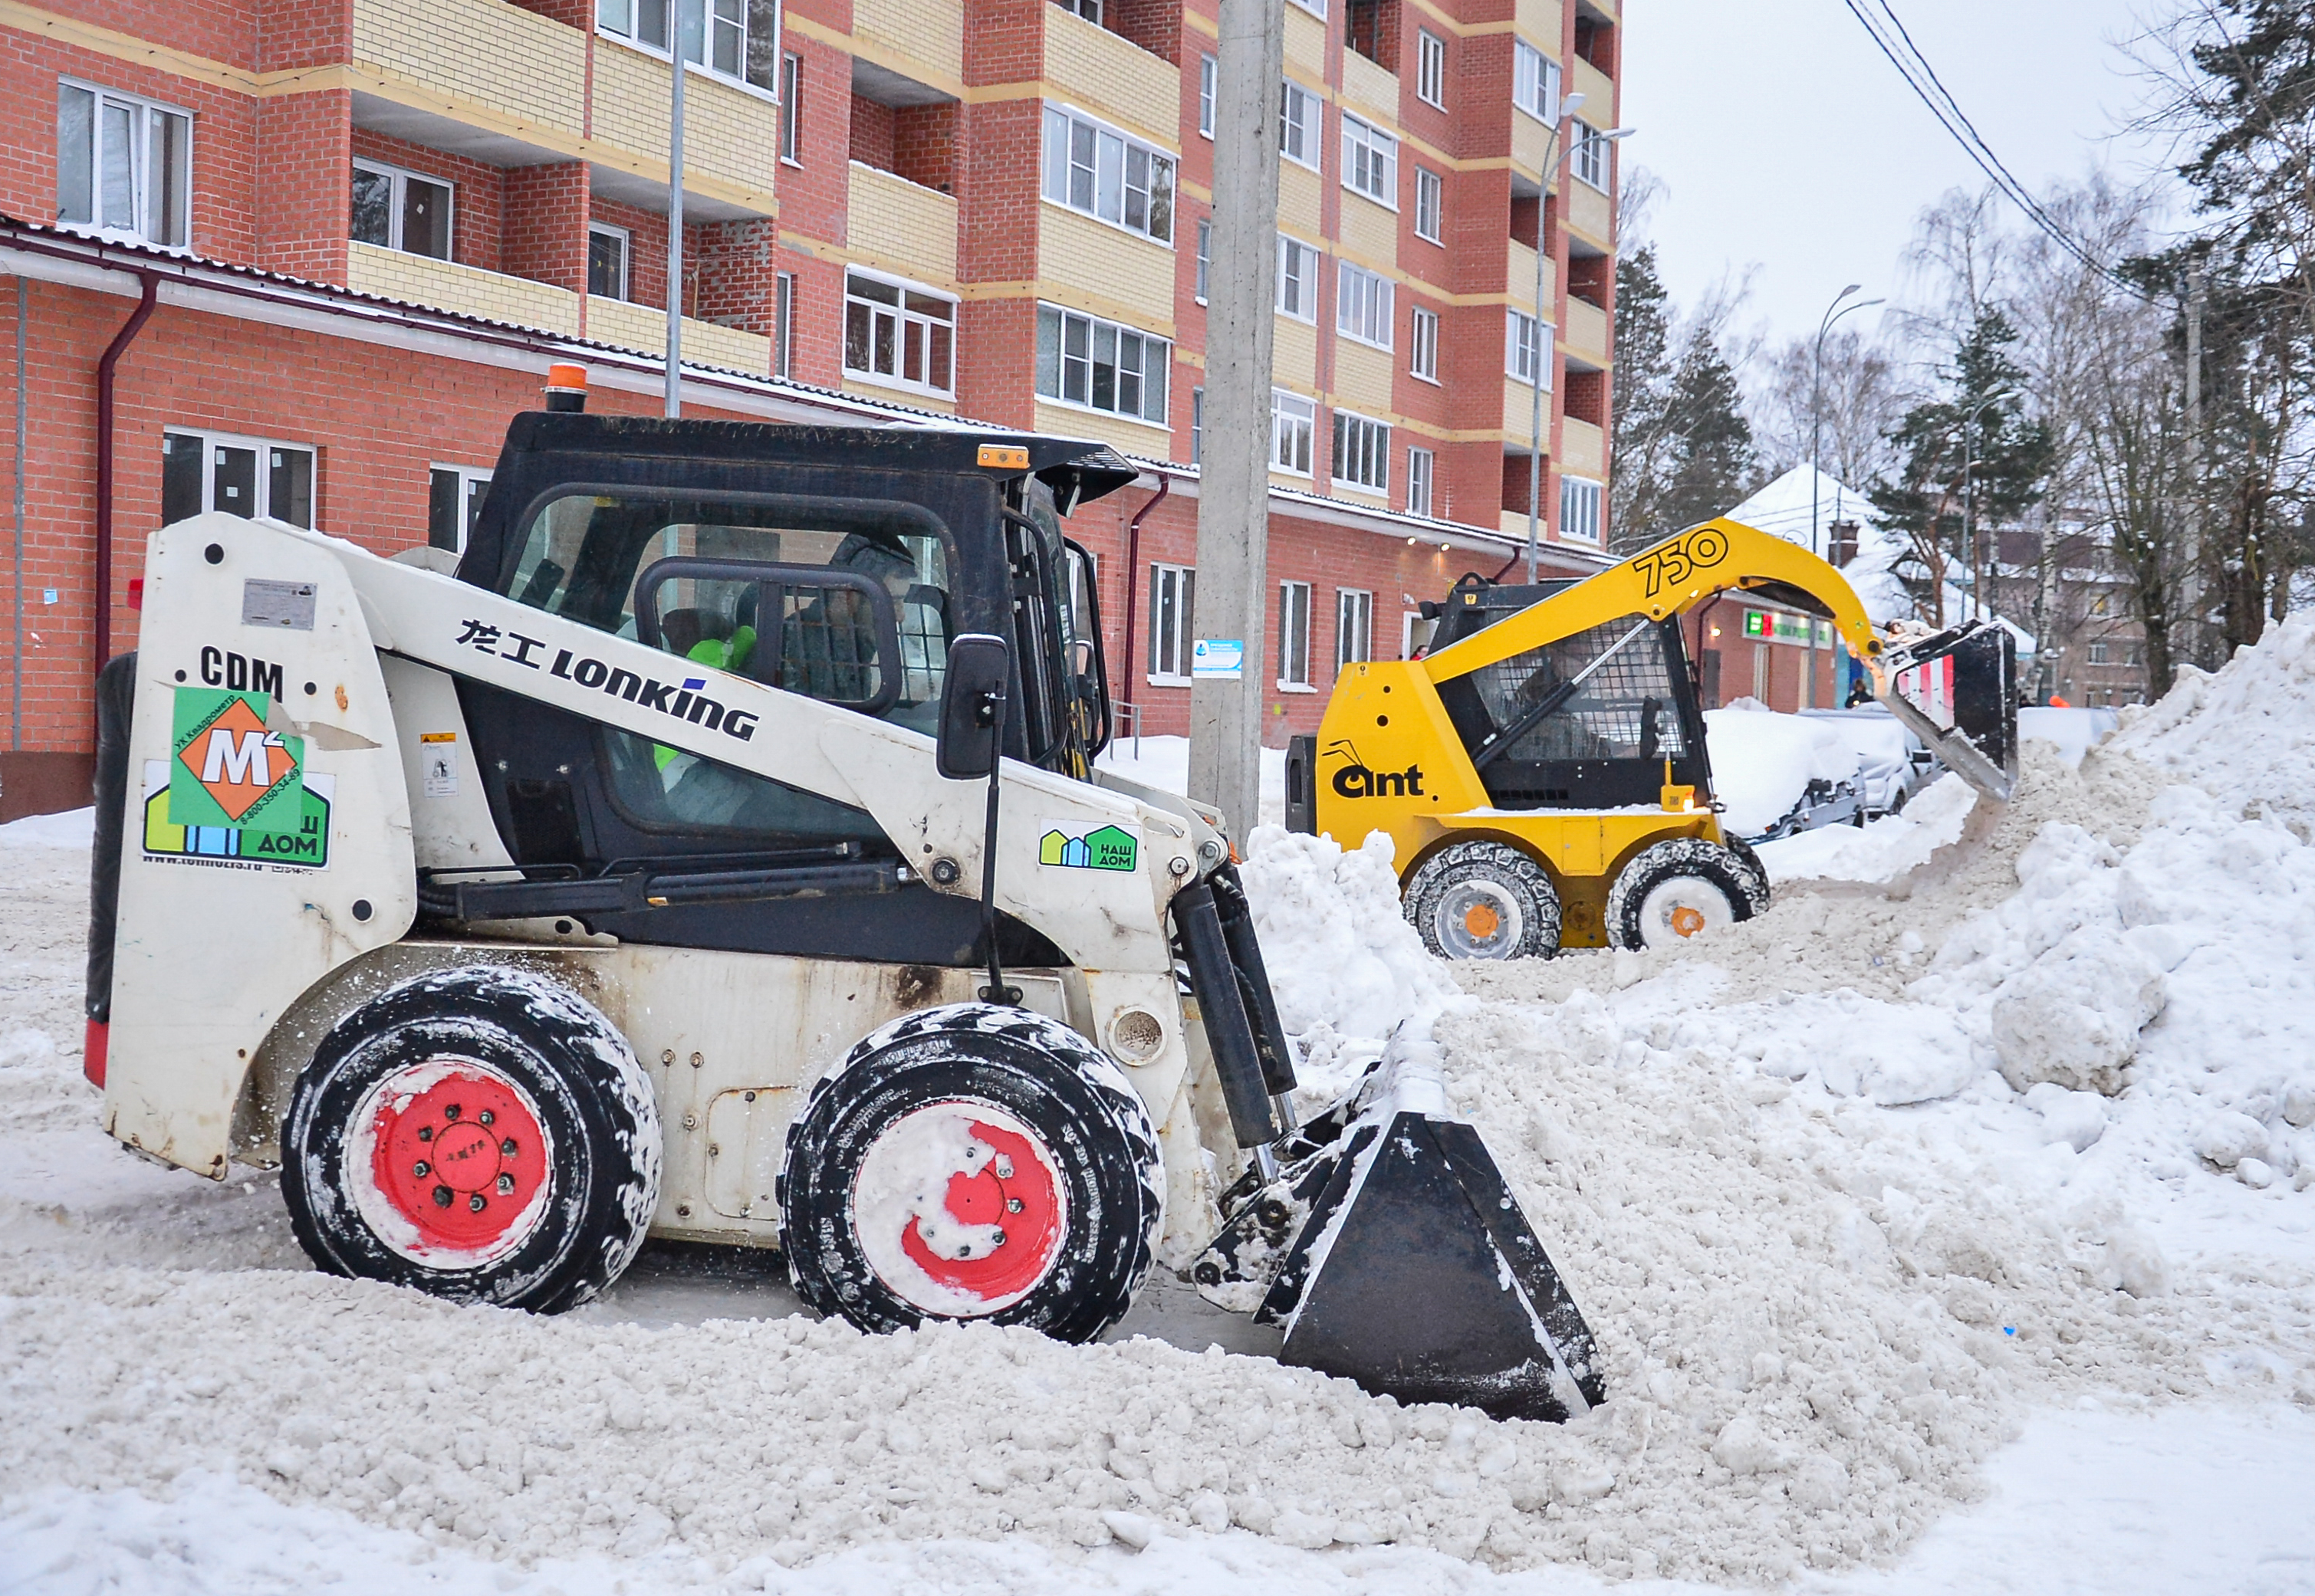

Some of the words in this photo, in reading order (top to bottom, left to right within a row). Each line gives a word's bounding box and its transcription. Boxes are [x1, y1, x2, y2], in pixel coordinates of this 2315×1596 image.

[1633, 528, 1728, 599] 750
[455, 619, 545, 669] 龙工
[201, 645, 283, 704] CDM
[240, 768, 301, 826] 8-800-350-34-89
[258, 835, 317, 856] ДОМ
[1099, 855, 1131, 867] ДОМ
[1100, 843, 1132, 855] НАШ
